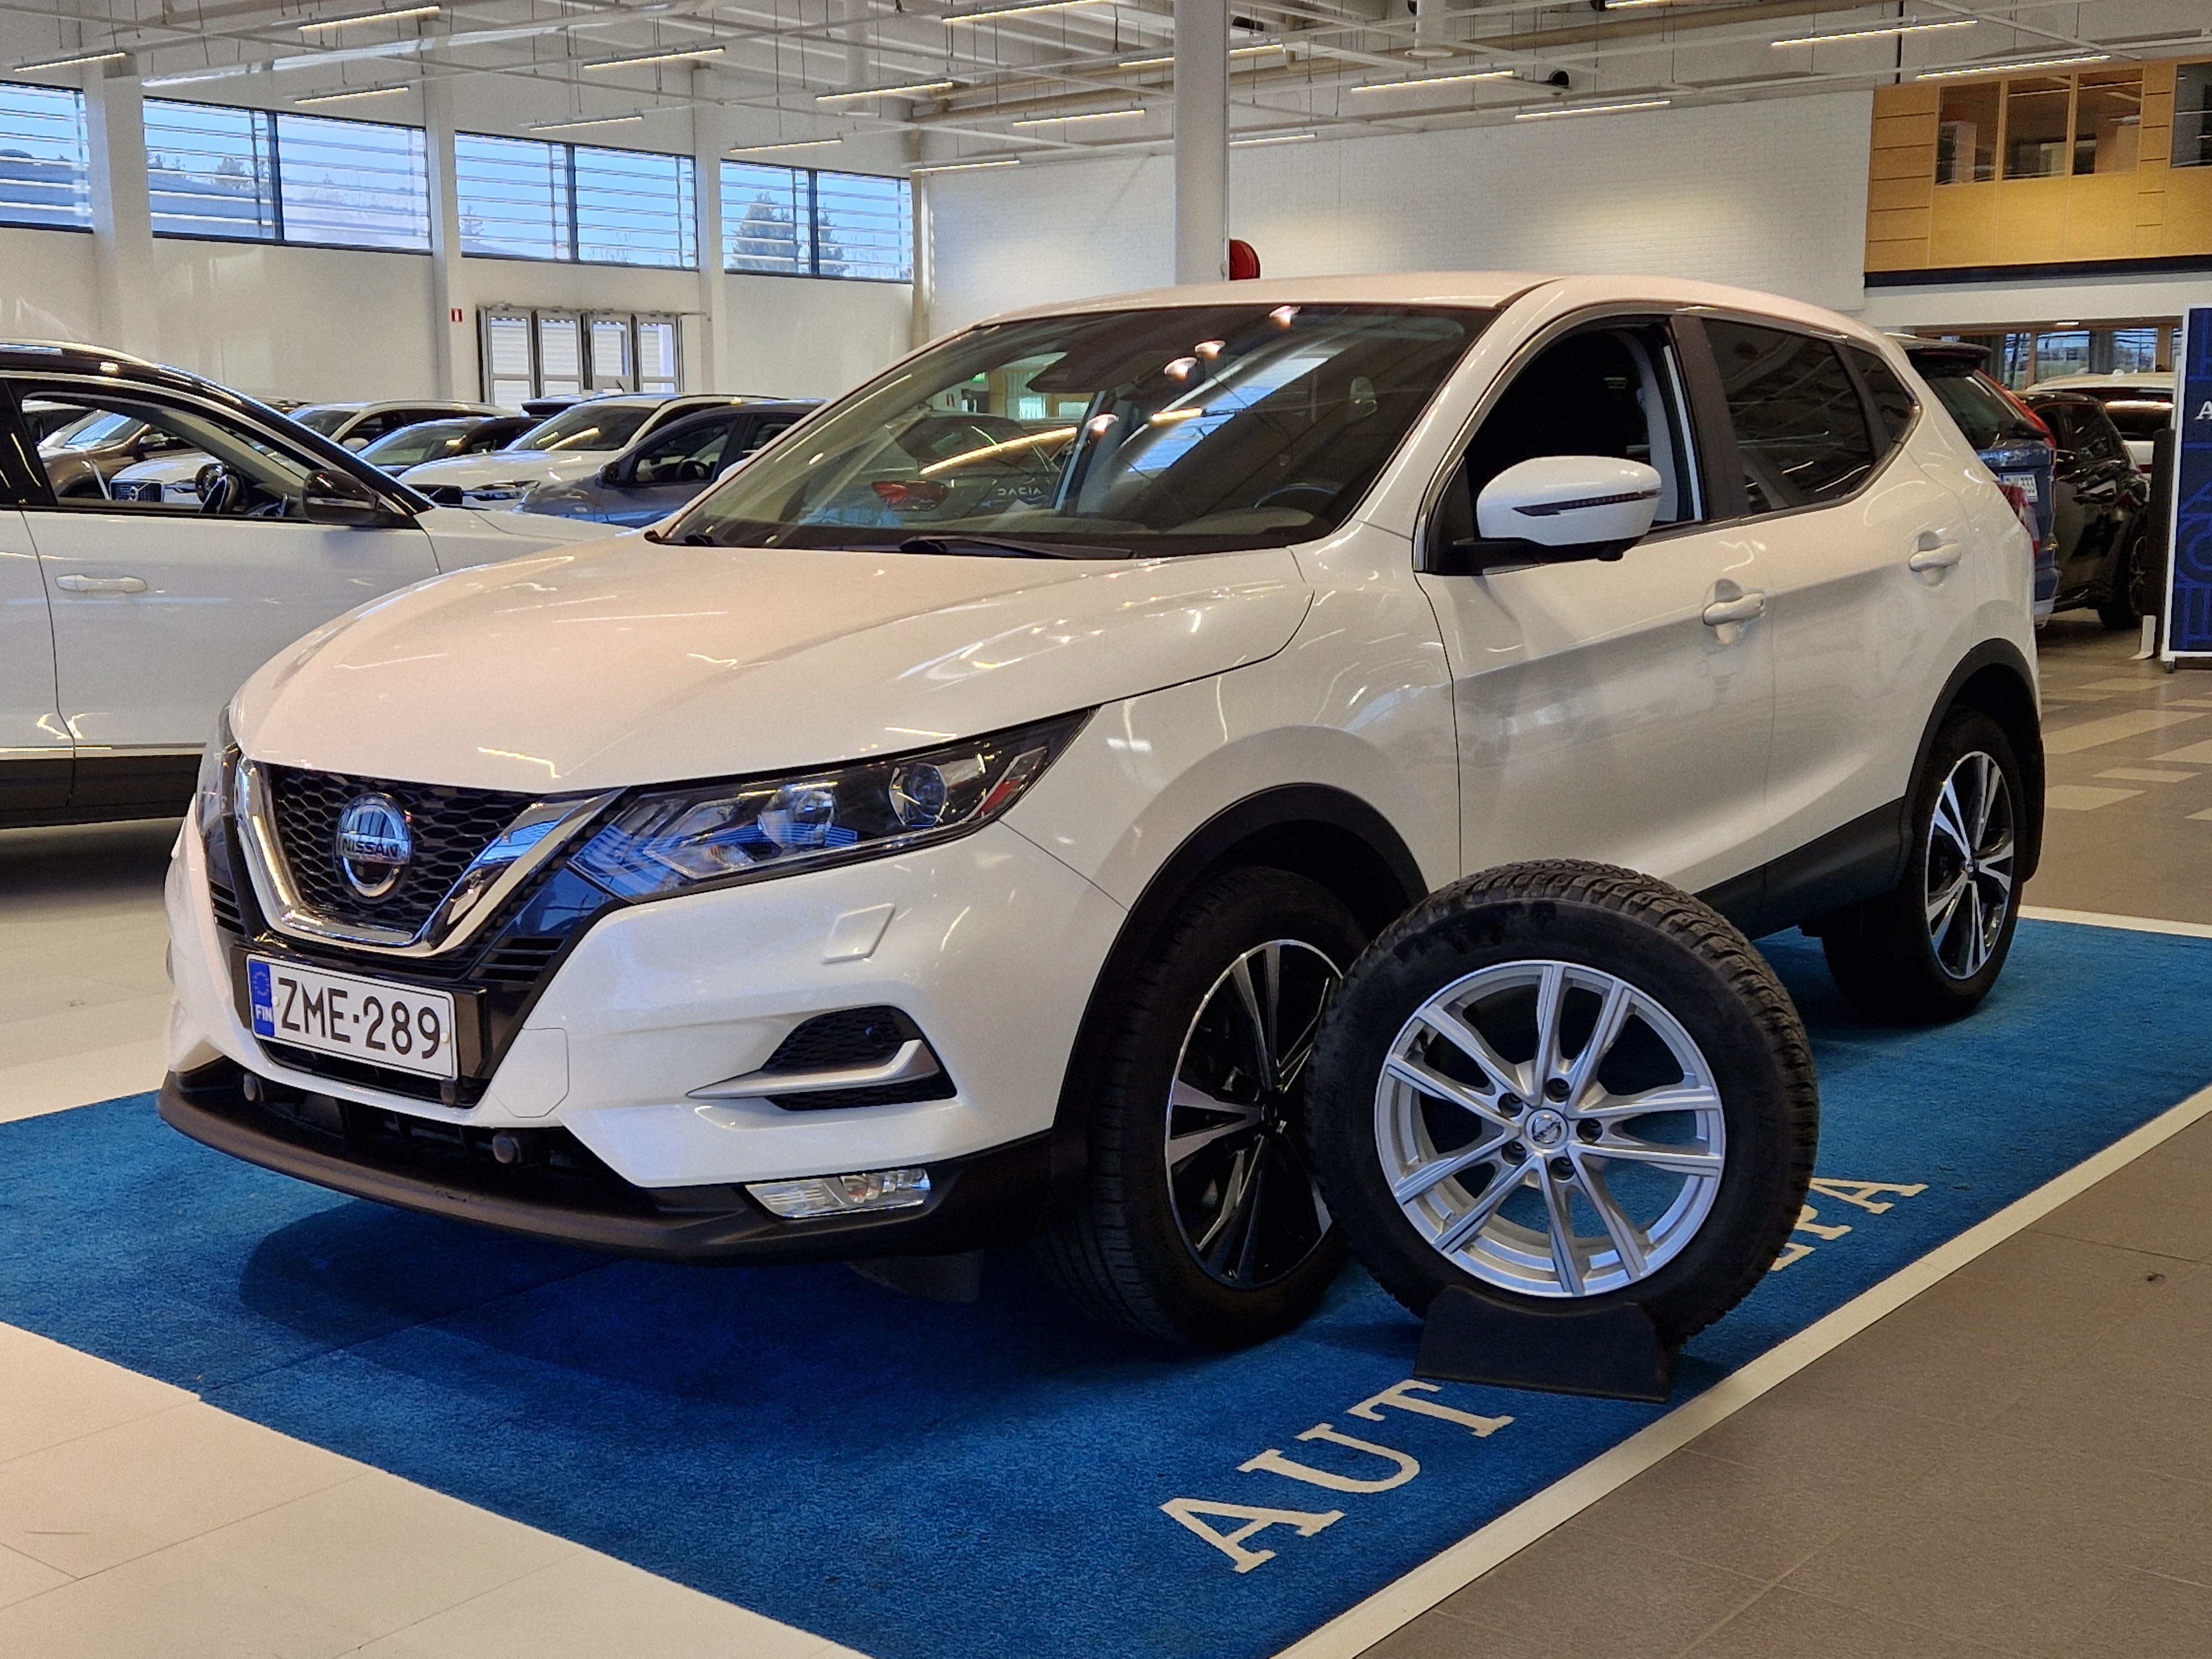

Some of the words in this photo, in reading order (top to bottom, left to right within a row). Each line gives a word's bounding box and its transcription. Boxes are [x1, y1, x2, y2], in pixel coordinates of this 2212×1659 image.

[997, 487, 1042, 496] DACIA
[342, 837, 400, 857] NISSAN
[256, 1004, 273, 1022] FIN
